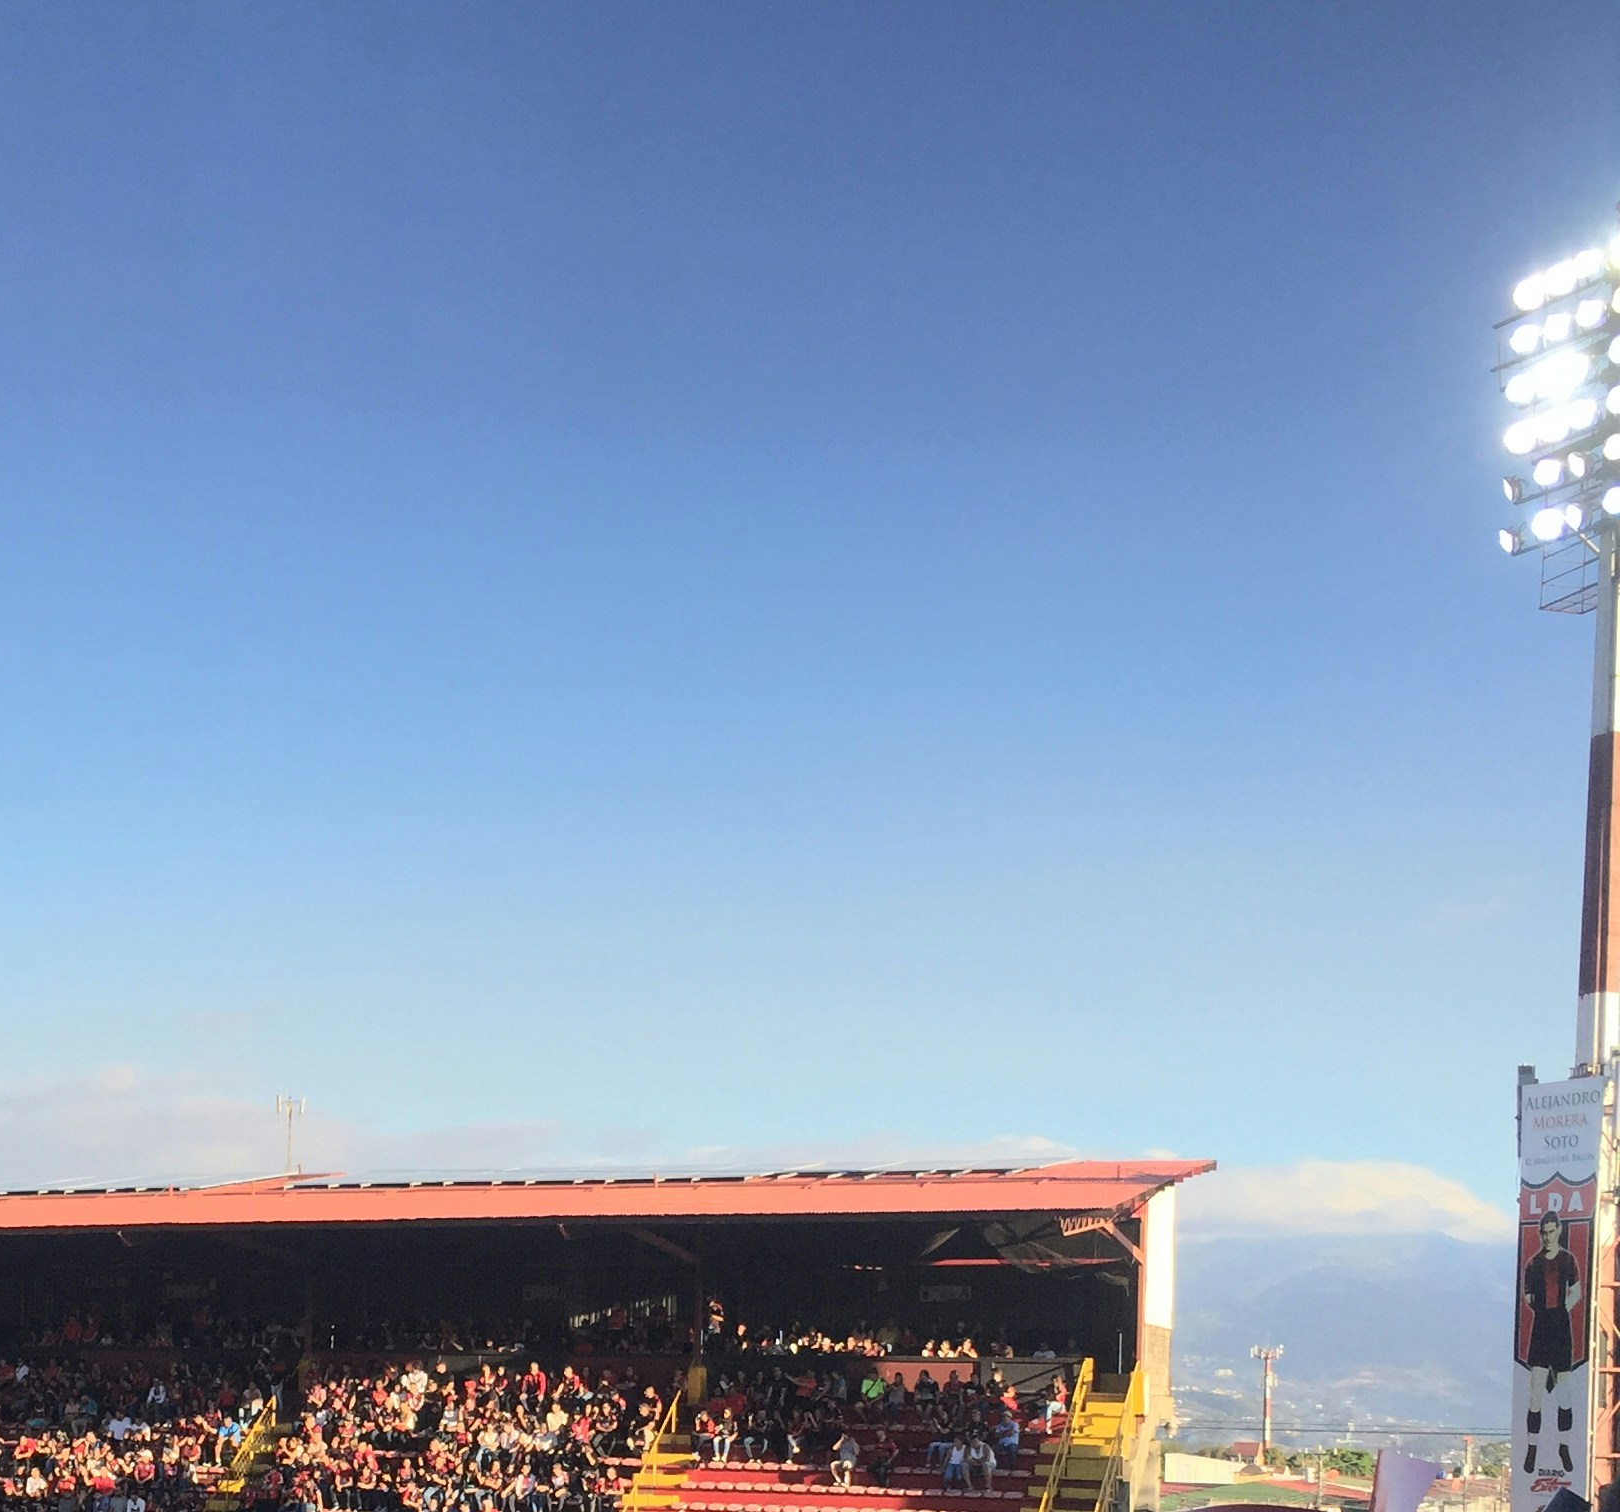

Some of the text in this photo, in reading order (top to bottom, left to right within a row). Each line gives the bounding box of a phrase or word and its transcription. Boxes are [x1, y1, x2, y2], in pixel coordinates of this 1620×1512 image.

[1525, 1089, 1601, 1112] ALEJANDRO
[1532, 1113, 1588, 1130] MORERA
[1543, 1134, 1579, 1150] SOTO
[1529, 1191, 1585, 1215] LDA
